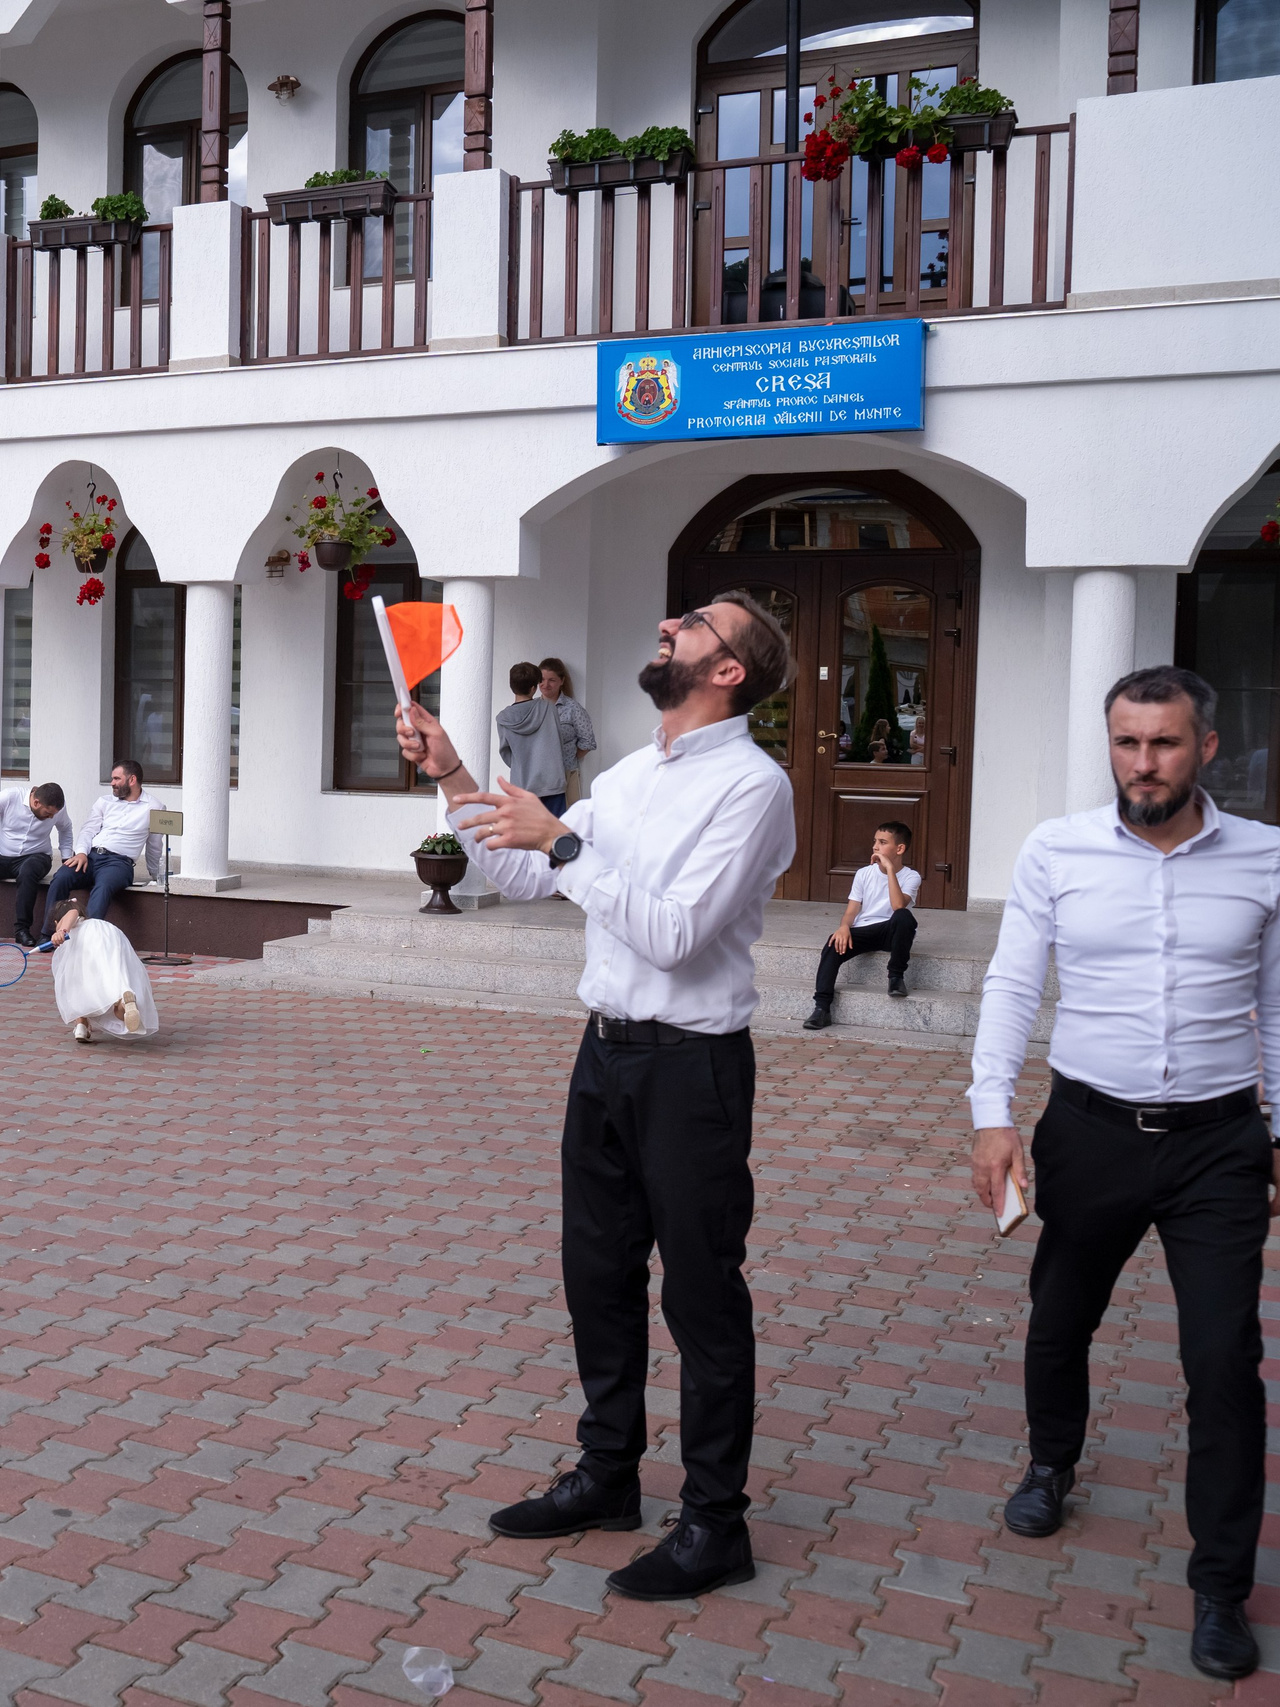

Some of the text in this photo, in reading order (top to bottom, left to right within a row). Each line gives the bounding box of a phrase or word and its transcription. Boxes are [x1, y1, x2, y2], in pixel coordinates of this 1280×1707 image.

[692, 342, 791, 360] ARHIEPISCOPIA
[712, 353, 877, 373] CENTRUL SOCIAL PASTORAL
[776, 395, 818, 407] PROROC
[823, 392, 865, 405] DANIEL
[687, 413, 766, 430] PROTOIERIA
[829, 409, 847, 422] DE
[854, 406, 902, 420] MUNTE
